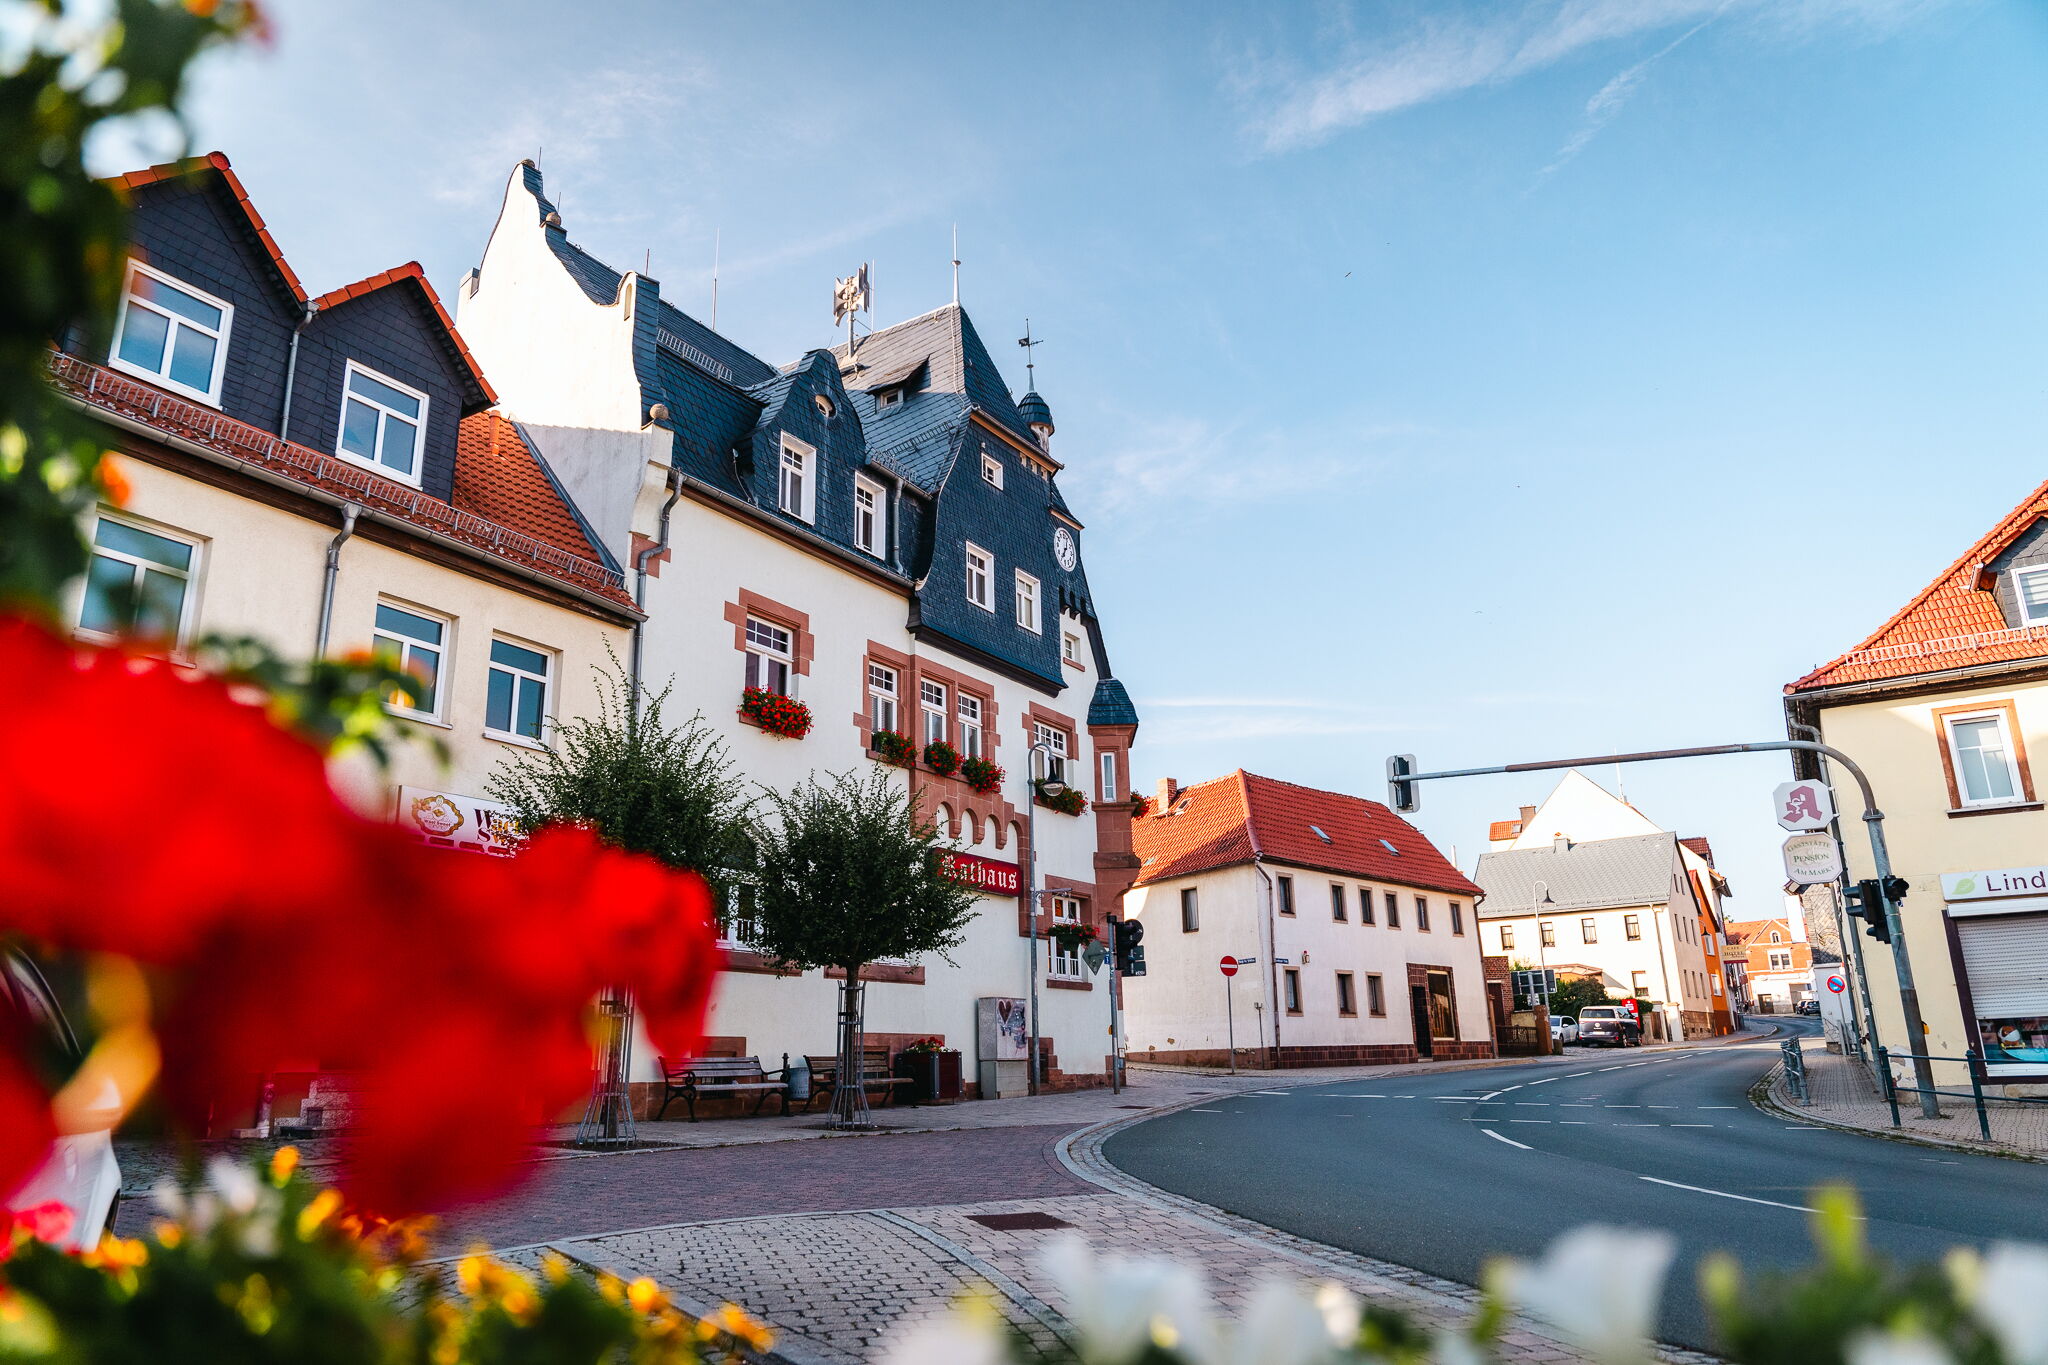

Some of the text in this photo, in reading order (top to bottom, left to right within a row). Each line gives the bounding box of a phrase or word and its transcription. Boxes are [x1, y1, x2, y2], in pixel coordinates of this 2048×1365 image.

[1793, 853, 1830, 863] PENSION
[942, 853, 1017, 889] Rathaus
[1985, 870, 2047, 892] Lind
